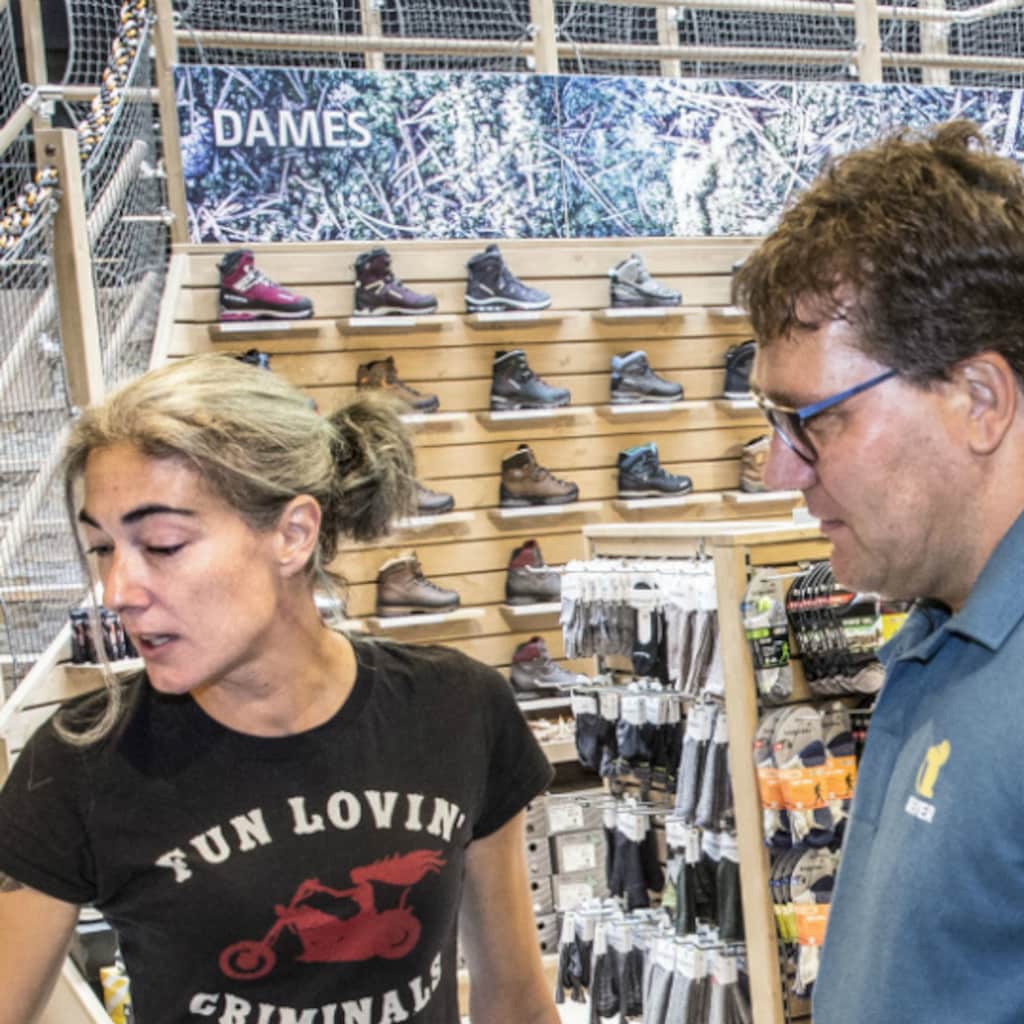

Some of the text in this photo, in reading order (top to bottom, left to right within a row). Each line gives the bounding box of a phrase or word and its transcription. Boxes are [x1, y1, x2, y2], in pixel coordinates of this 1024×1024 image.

[213, 109, 373, 149] DAMES
[155, 790, 467, 883] FUN LOVIN'
